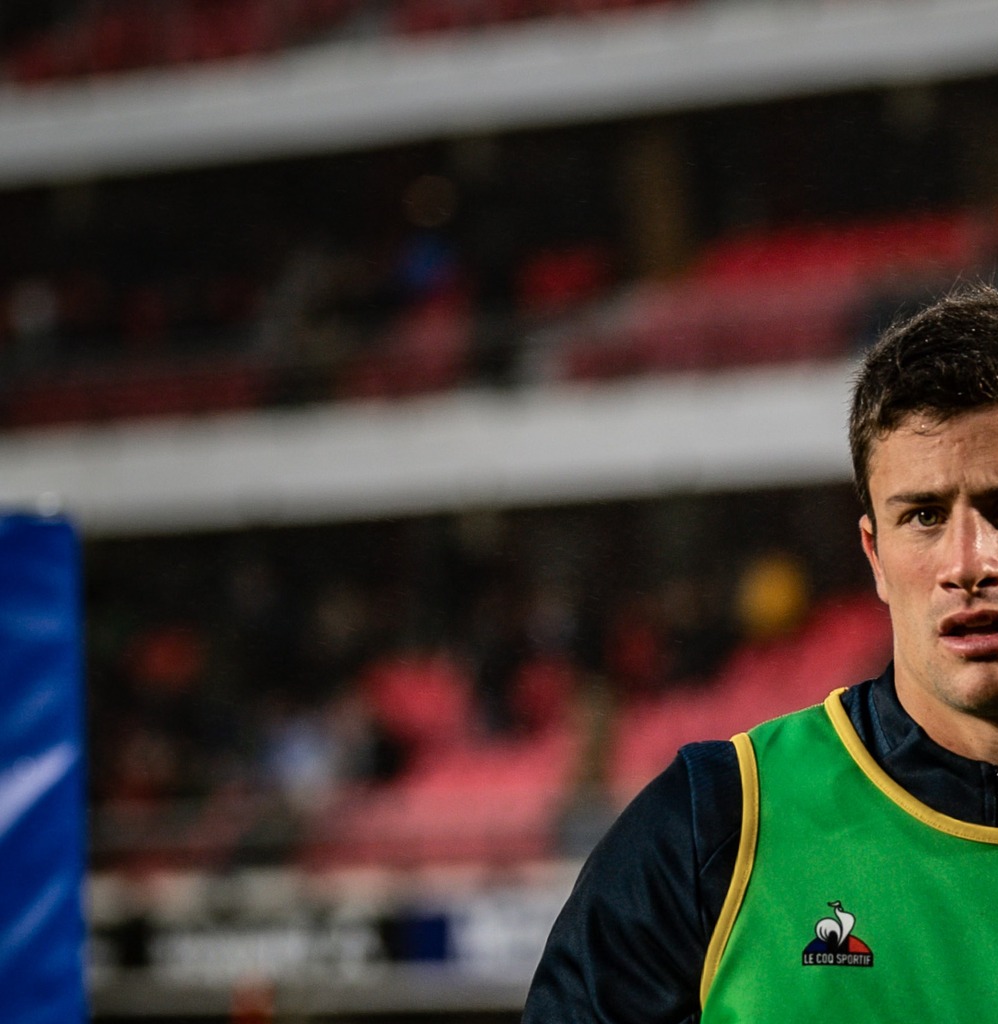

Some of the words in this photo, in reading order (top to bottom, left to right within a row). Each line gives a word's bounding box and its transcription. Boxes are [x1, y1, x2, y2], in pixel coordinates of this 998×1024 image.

[804, 953, 814, 964] LE
[816, 953, 834, 964] COQ
[836, 954, 871, 965] SPORTIF
